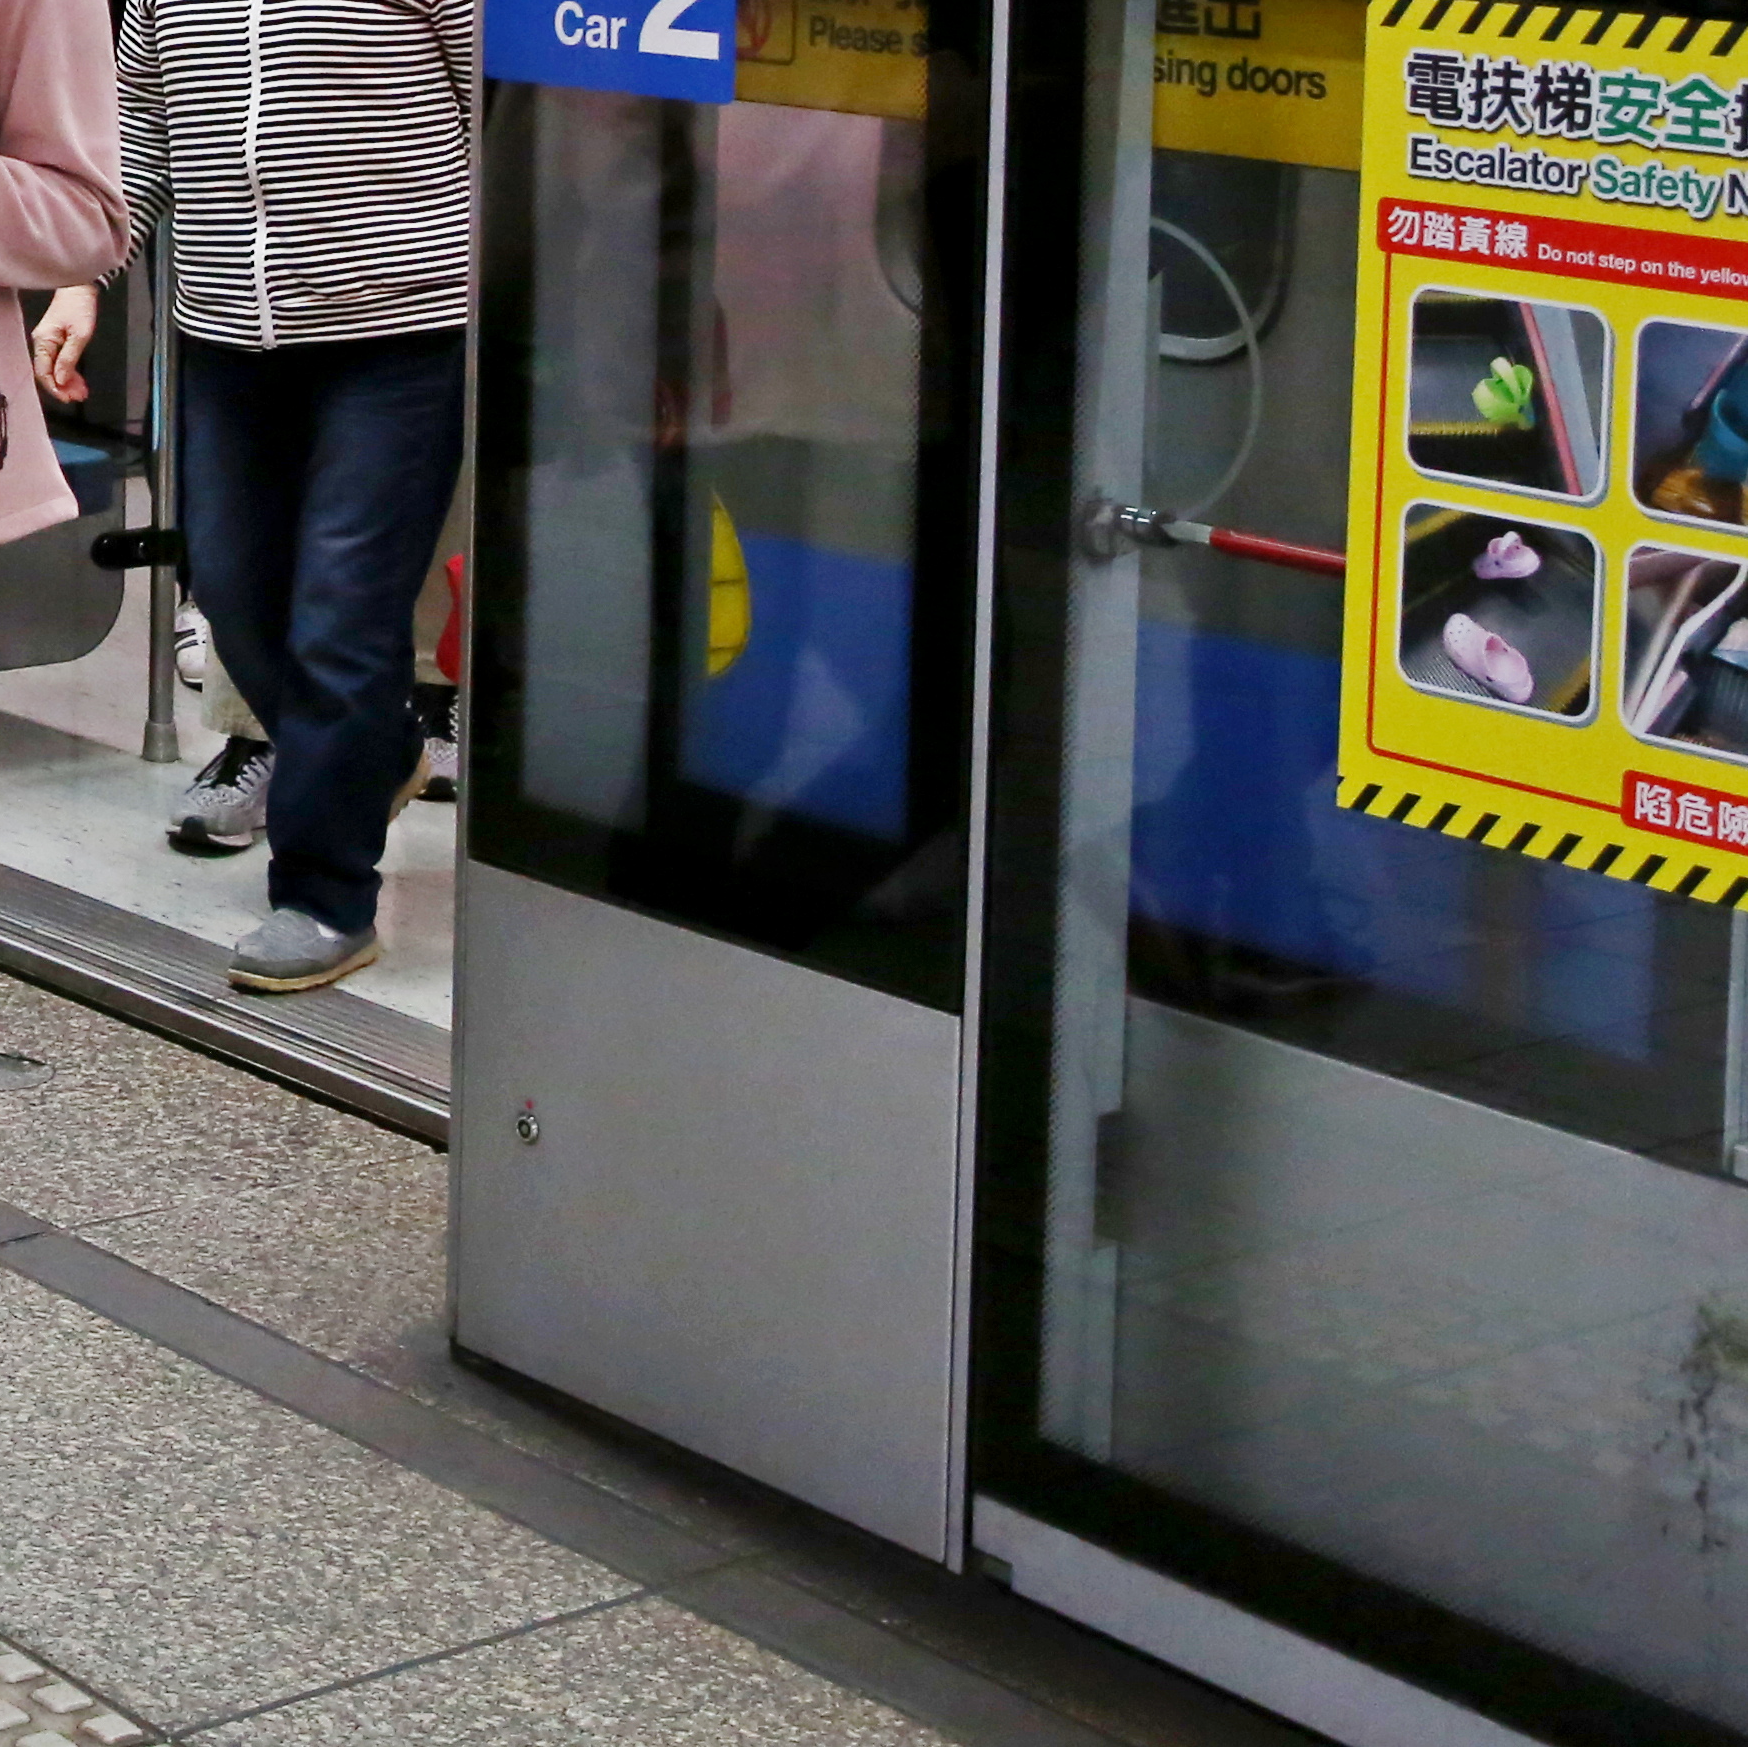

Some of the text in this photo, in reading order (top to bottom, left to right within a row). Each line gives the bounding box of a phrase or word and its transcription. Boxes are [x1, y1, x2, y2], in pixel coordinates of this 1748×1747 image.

[554, 0, 627, 50] Car
[809, 13, 903, 56] Please
[1153, 49, 1327, 100] sing doors
[1409, 137, 1582, 189] Escalator
[1592, 157, 1719, 214] Safety
[1387, 206, 1529, 260] 勿踏黃線
[1537, 243, 1562, 262] Do
[1566, 247, 1596, 267] not
[1598, 252, 1637, 274] step
[1641, 258, 1664, 276] on
[1667, 260, 1696, 279] the
